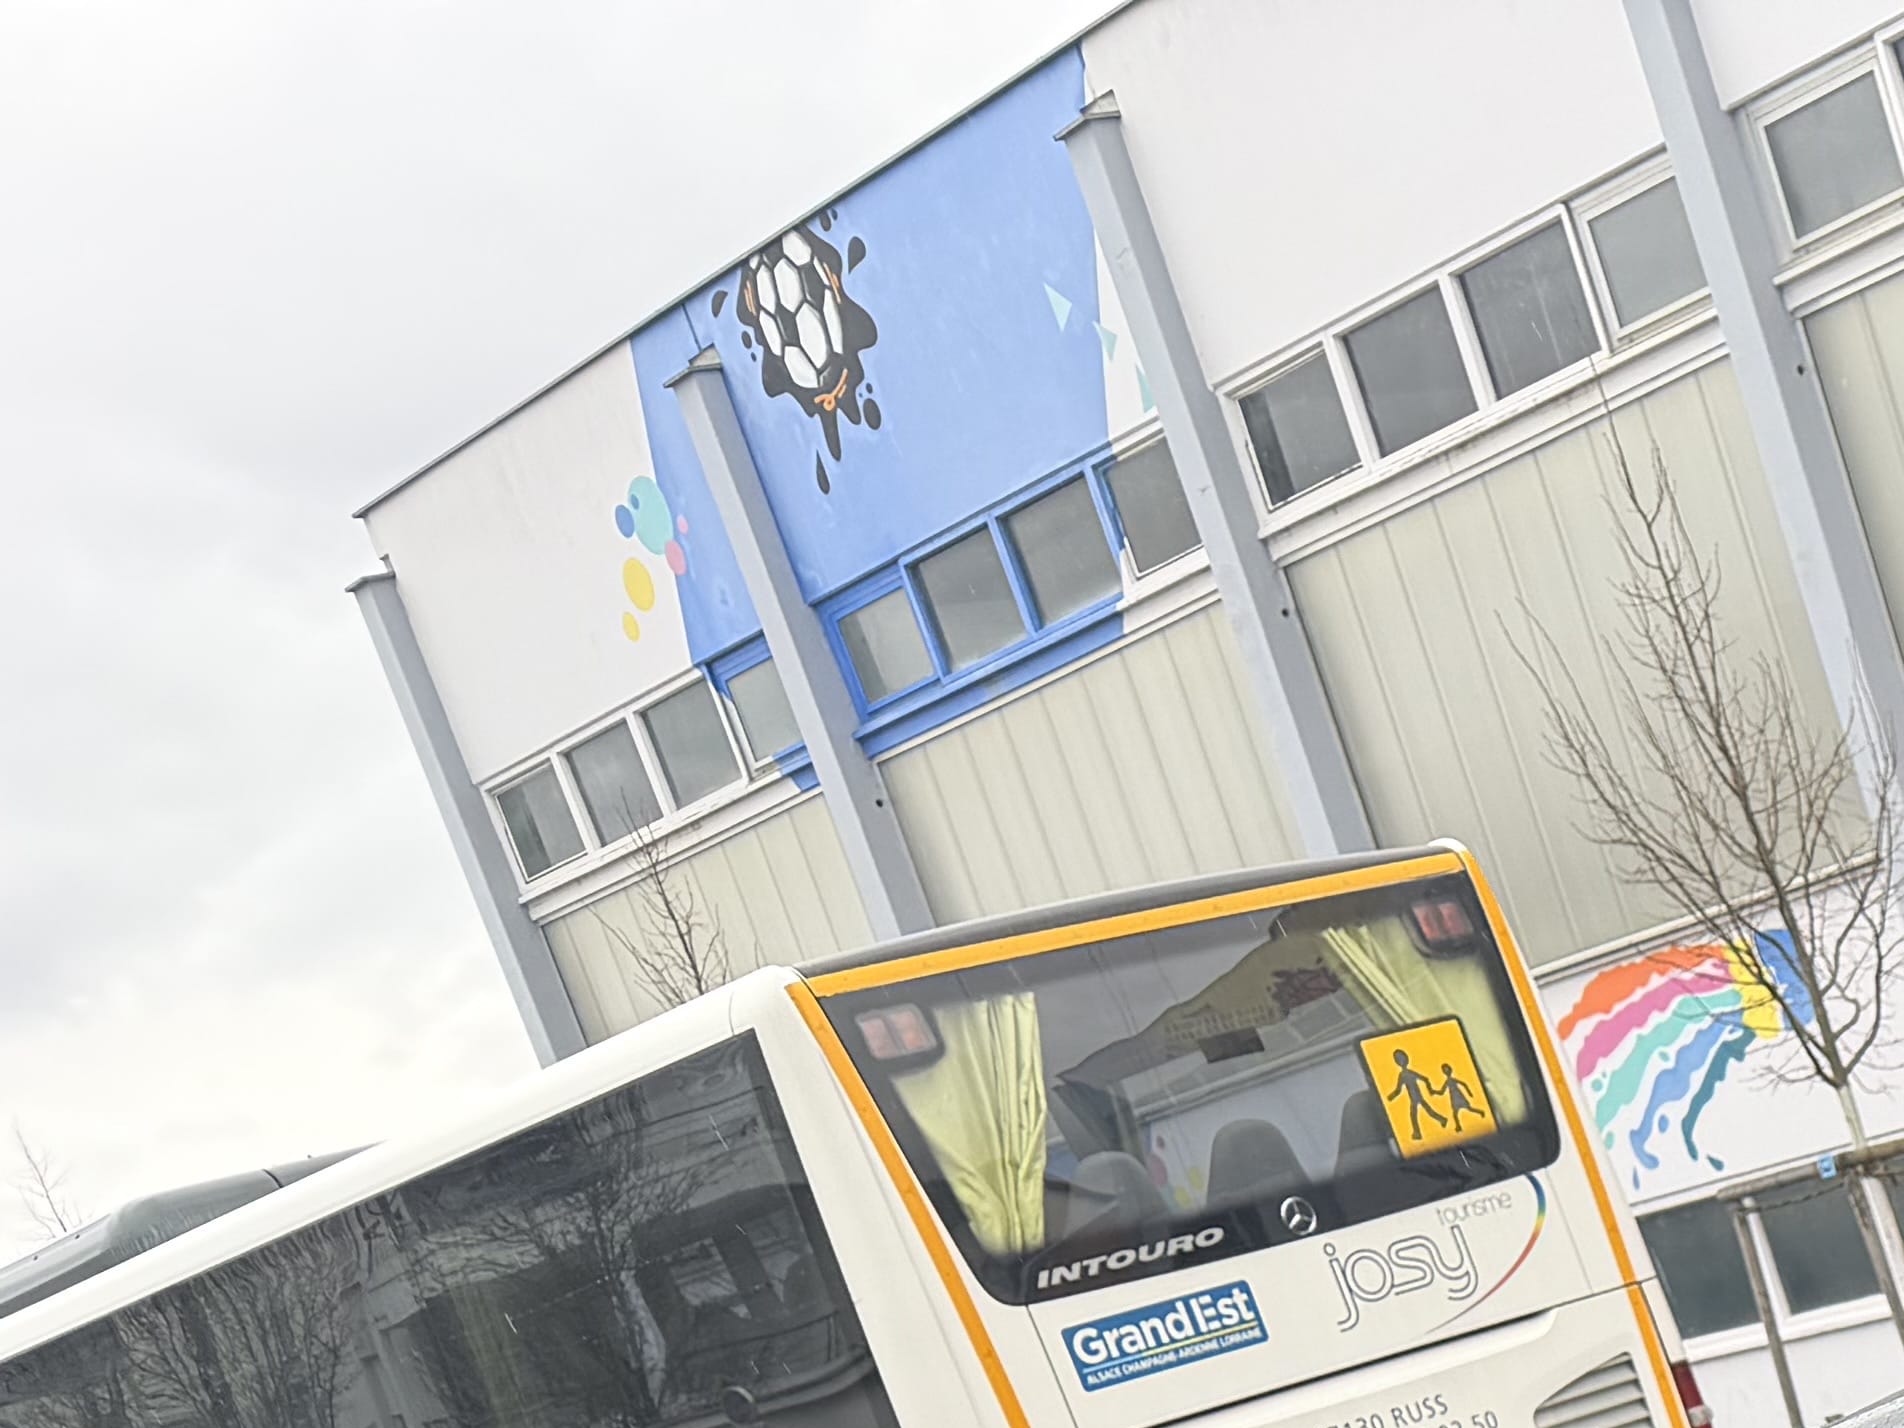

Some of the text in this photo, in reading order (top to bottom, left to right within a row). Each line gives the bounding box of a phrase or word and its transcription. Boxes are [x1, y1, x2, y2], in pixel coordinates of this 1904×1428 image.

[1436, 1191, 1513, 1227] tourisme
[1037, 1227, 1225, 1289] INTOURO
[1323, 1224, 1479, 1333] josy
[1086, 1366, 1122, 1386] ALSACE
[1391, 1393, 1449, 1428] RUSS
